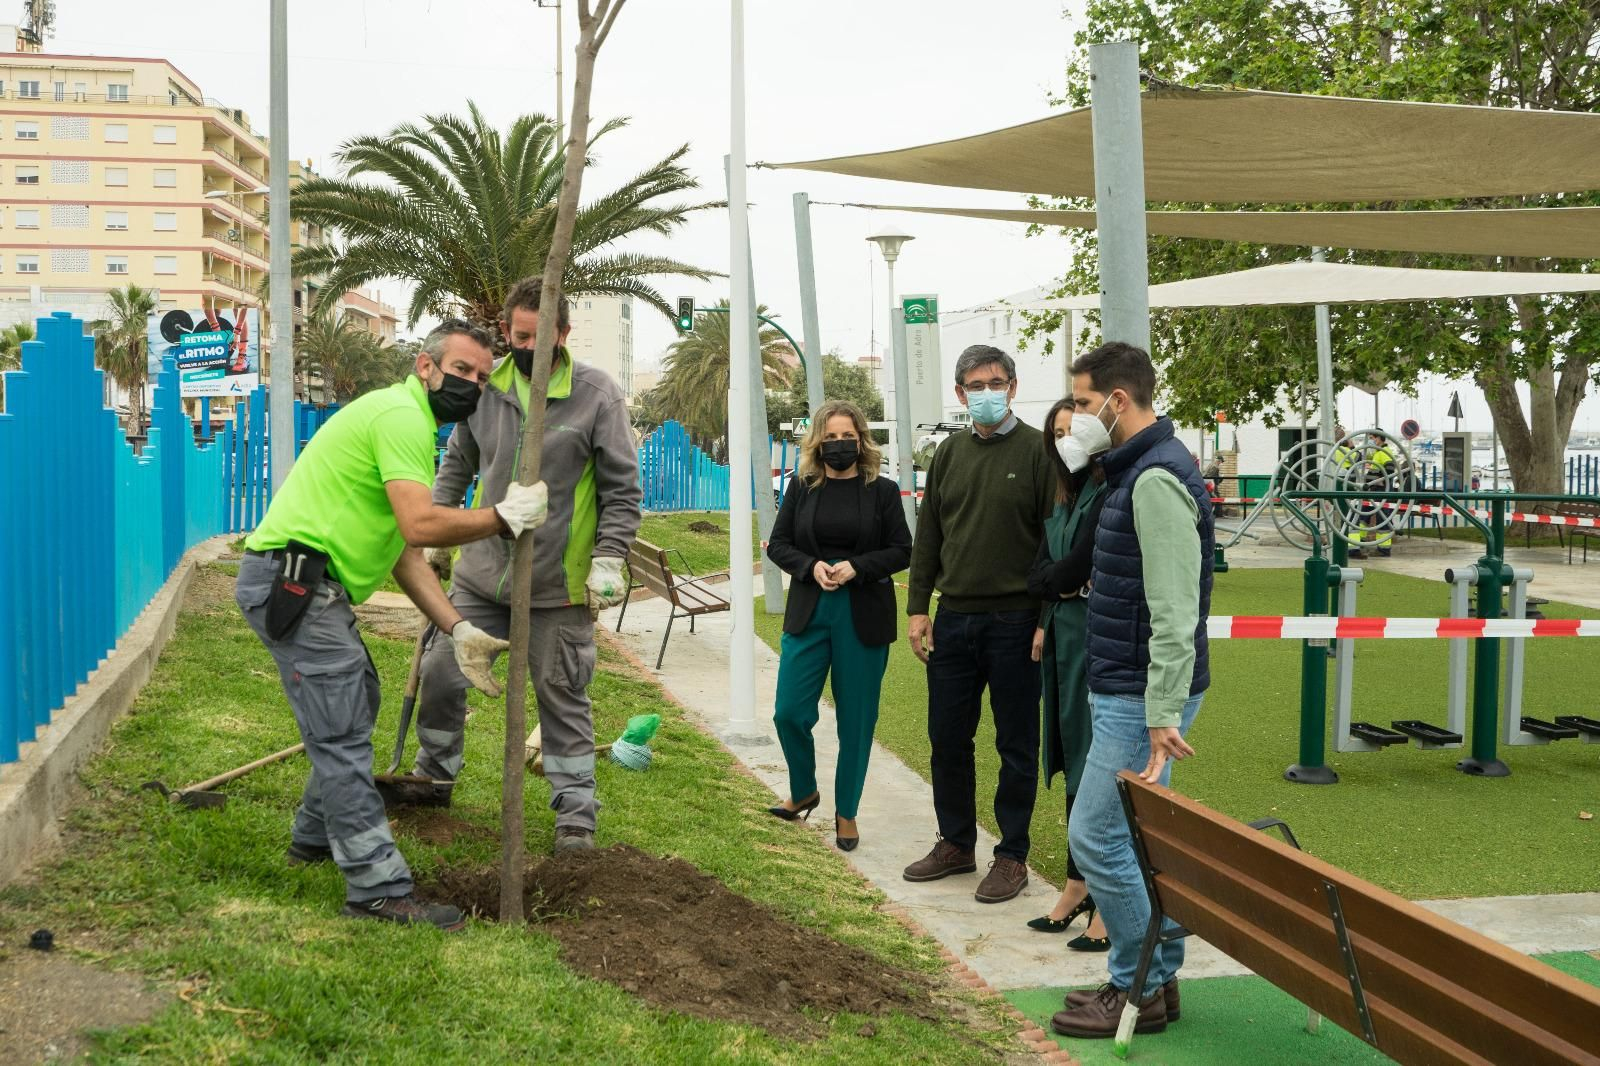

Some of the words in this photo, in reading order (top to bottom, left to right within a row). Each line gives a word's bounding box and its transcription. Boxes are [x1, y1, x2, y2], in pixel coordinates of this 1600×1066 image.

[184, 334, 223, 344] RETOMA
[185, 346, 225, 359] RITMO
[915, 350, 922, 359] de
[916, 361, 924, 385] Puerto
